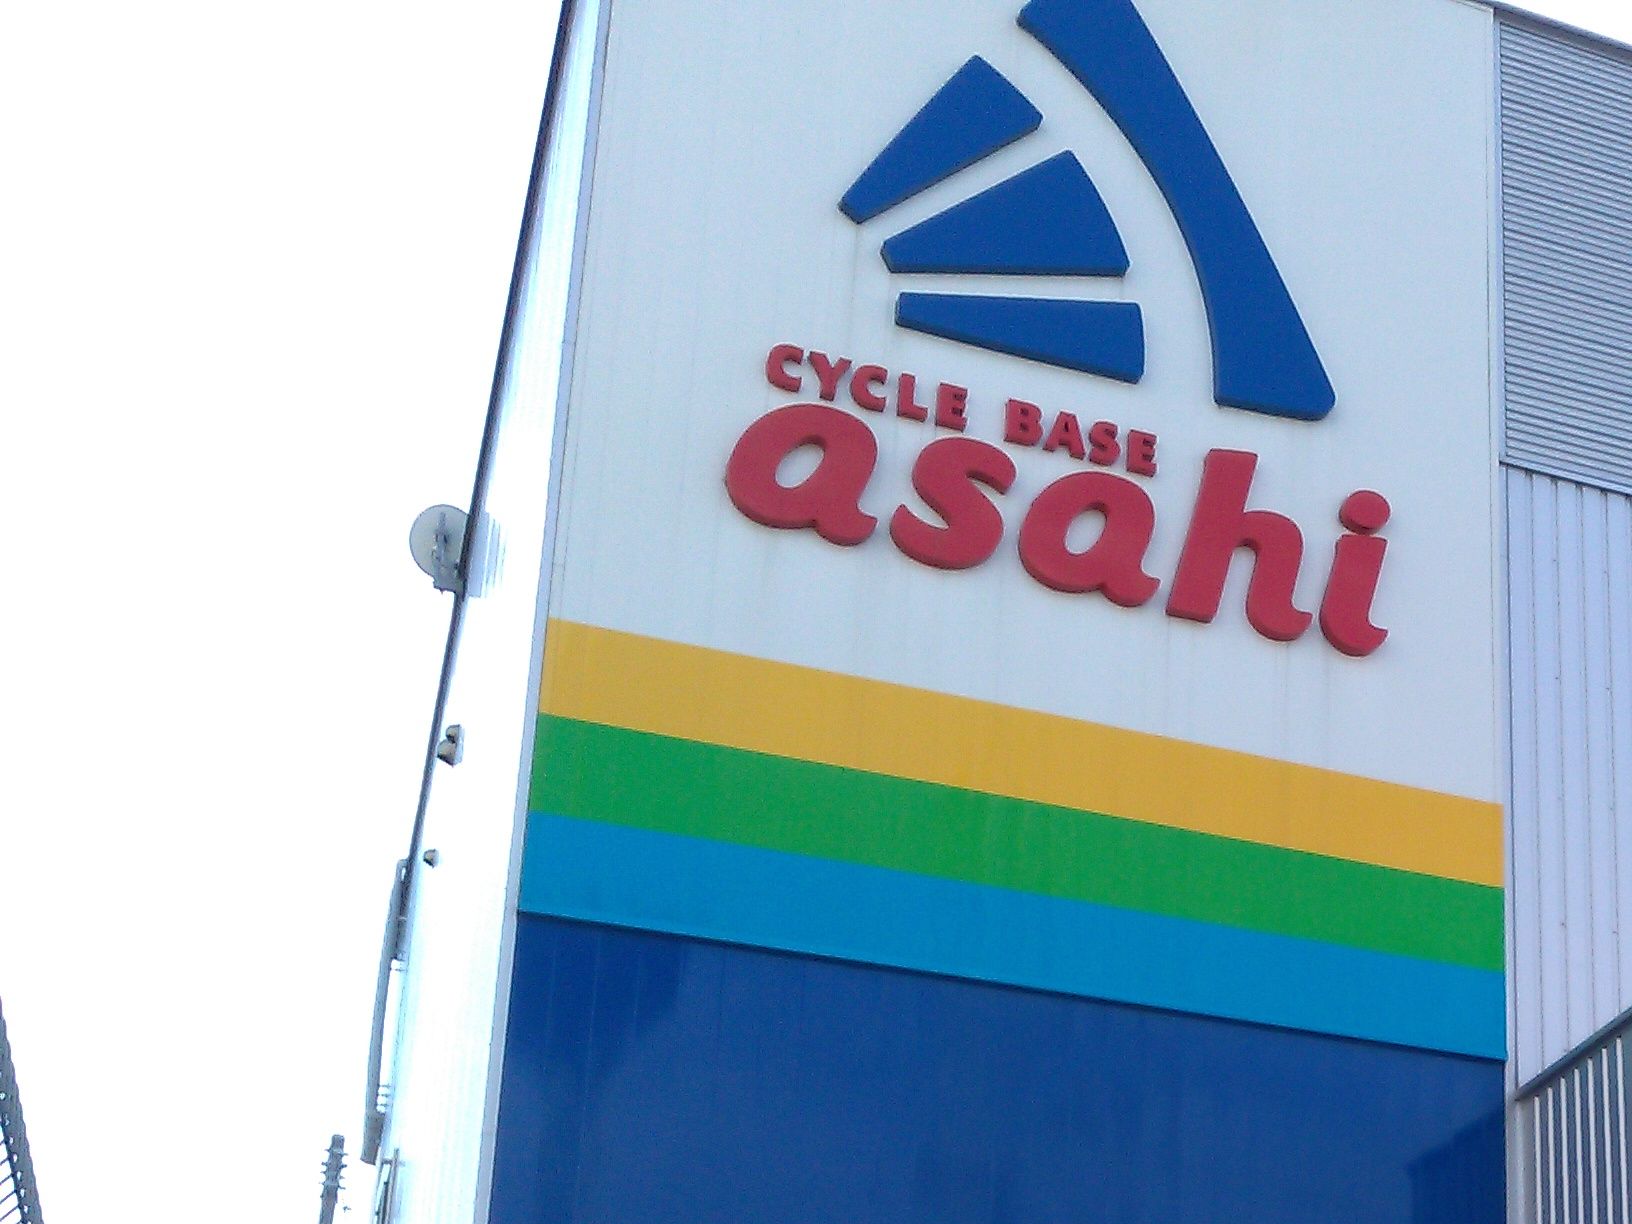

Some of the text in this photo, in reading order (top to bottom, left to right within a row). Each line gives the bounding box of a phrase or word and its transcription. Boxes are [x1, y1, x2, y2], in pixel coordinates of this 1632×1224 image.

[765, 343, 1158, 478] CYCLE BASE
[724, 403, 1389, 658] asahi
